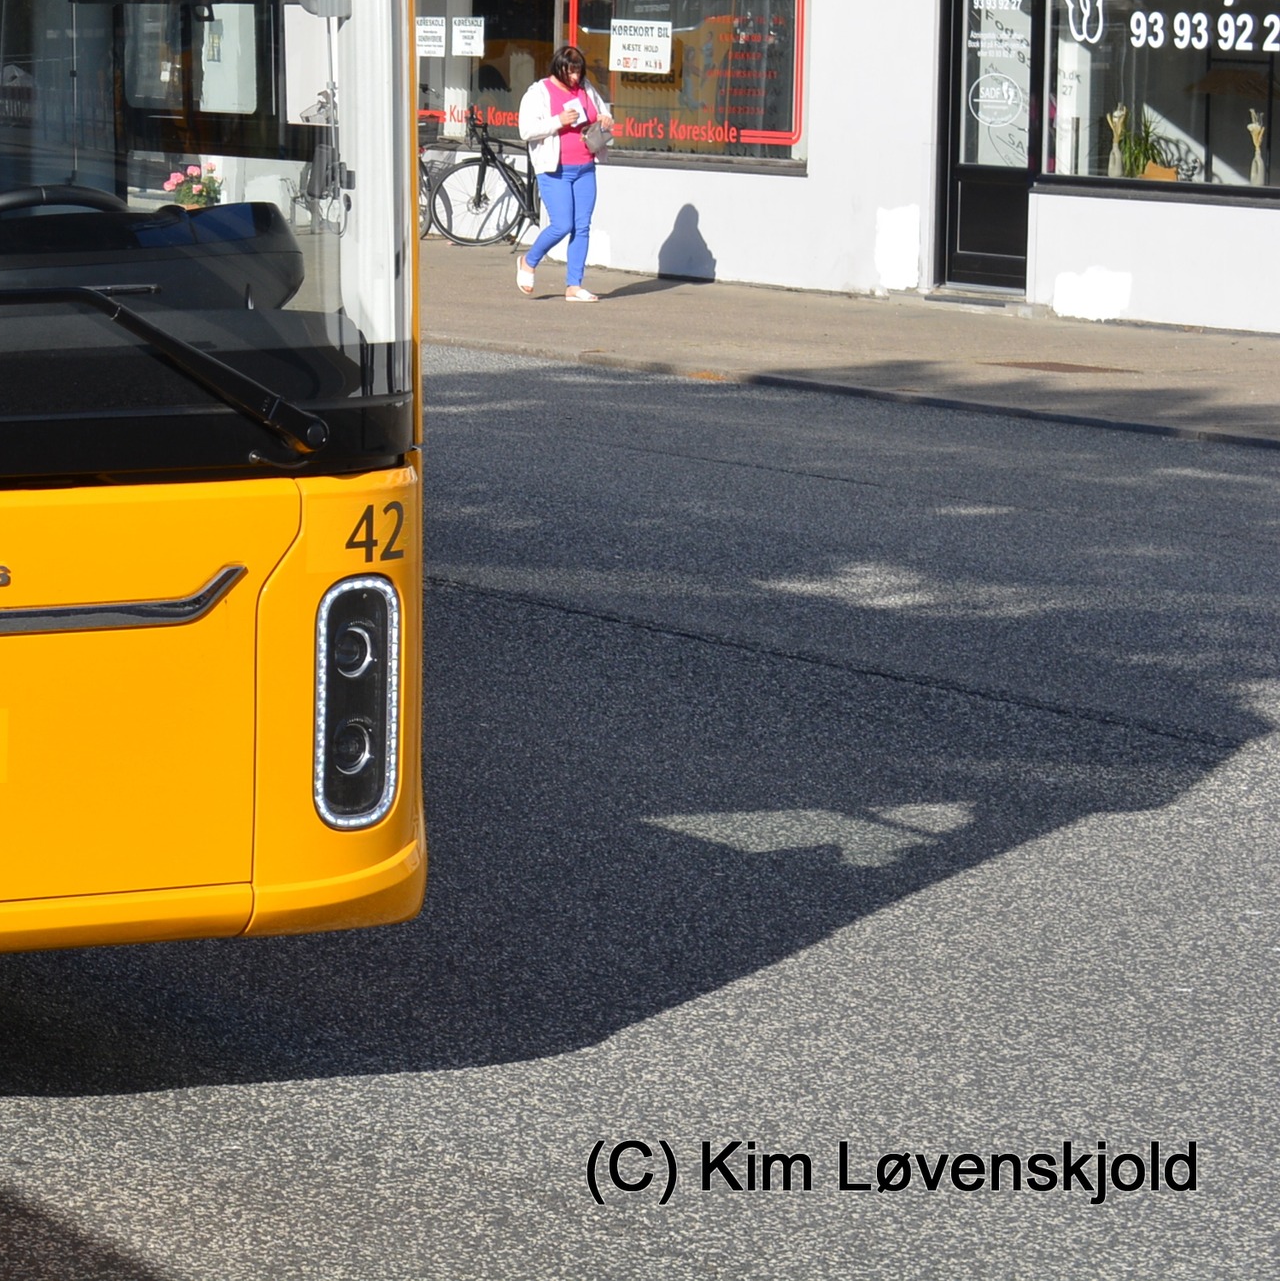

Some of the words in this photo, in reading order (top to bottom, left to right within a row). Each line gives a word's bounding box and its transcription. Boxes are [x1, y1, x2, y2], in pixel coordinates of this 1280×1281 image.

[612, 24, 654, 38] KØREKORT
[657, 27, 670, 39] BIL
[1130, 11, 1165, 49] 93
[1173, 11, 1209, 50] 93
[1217, 12, 1254, 51] 92
[980, 86, 1001, 99] SADF
[625, 117, 664, 139] Kurt's
[669, 118, 738, 143] Køreskole
[345, 500, 405, 563] 42
